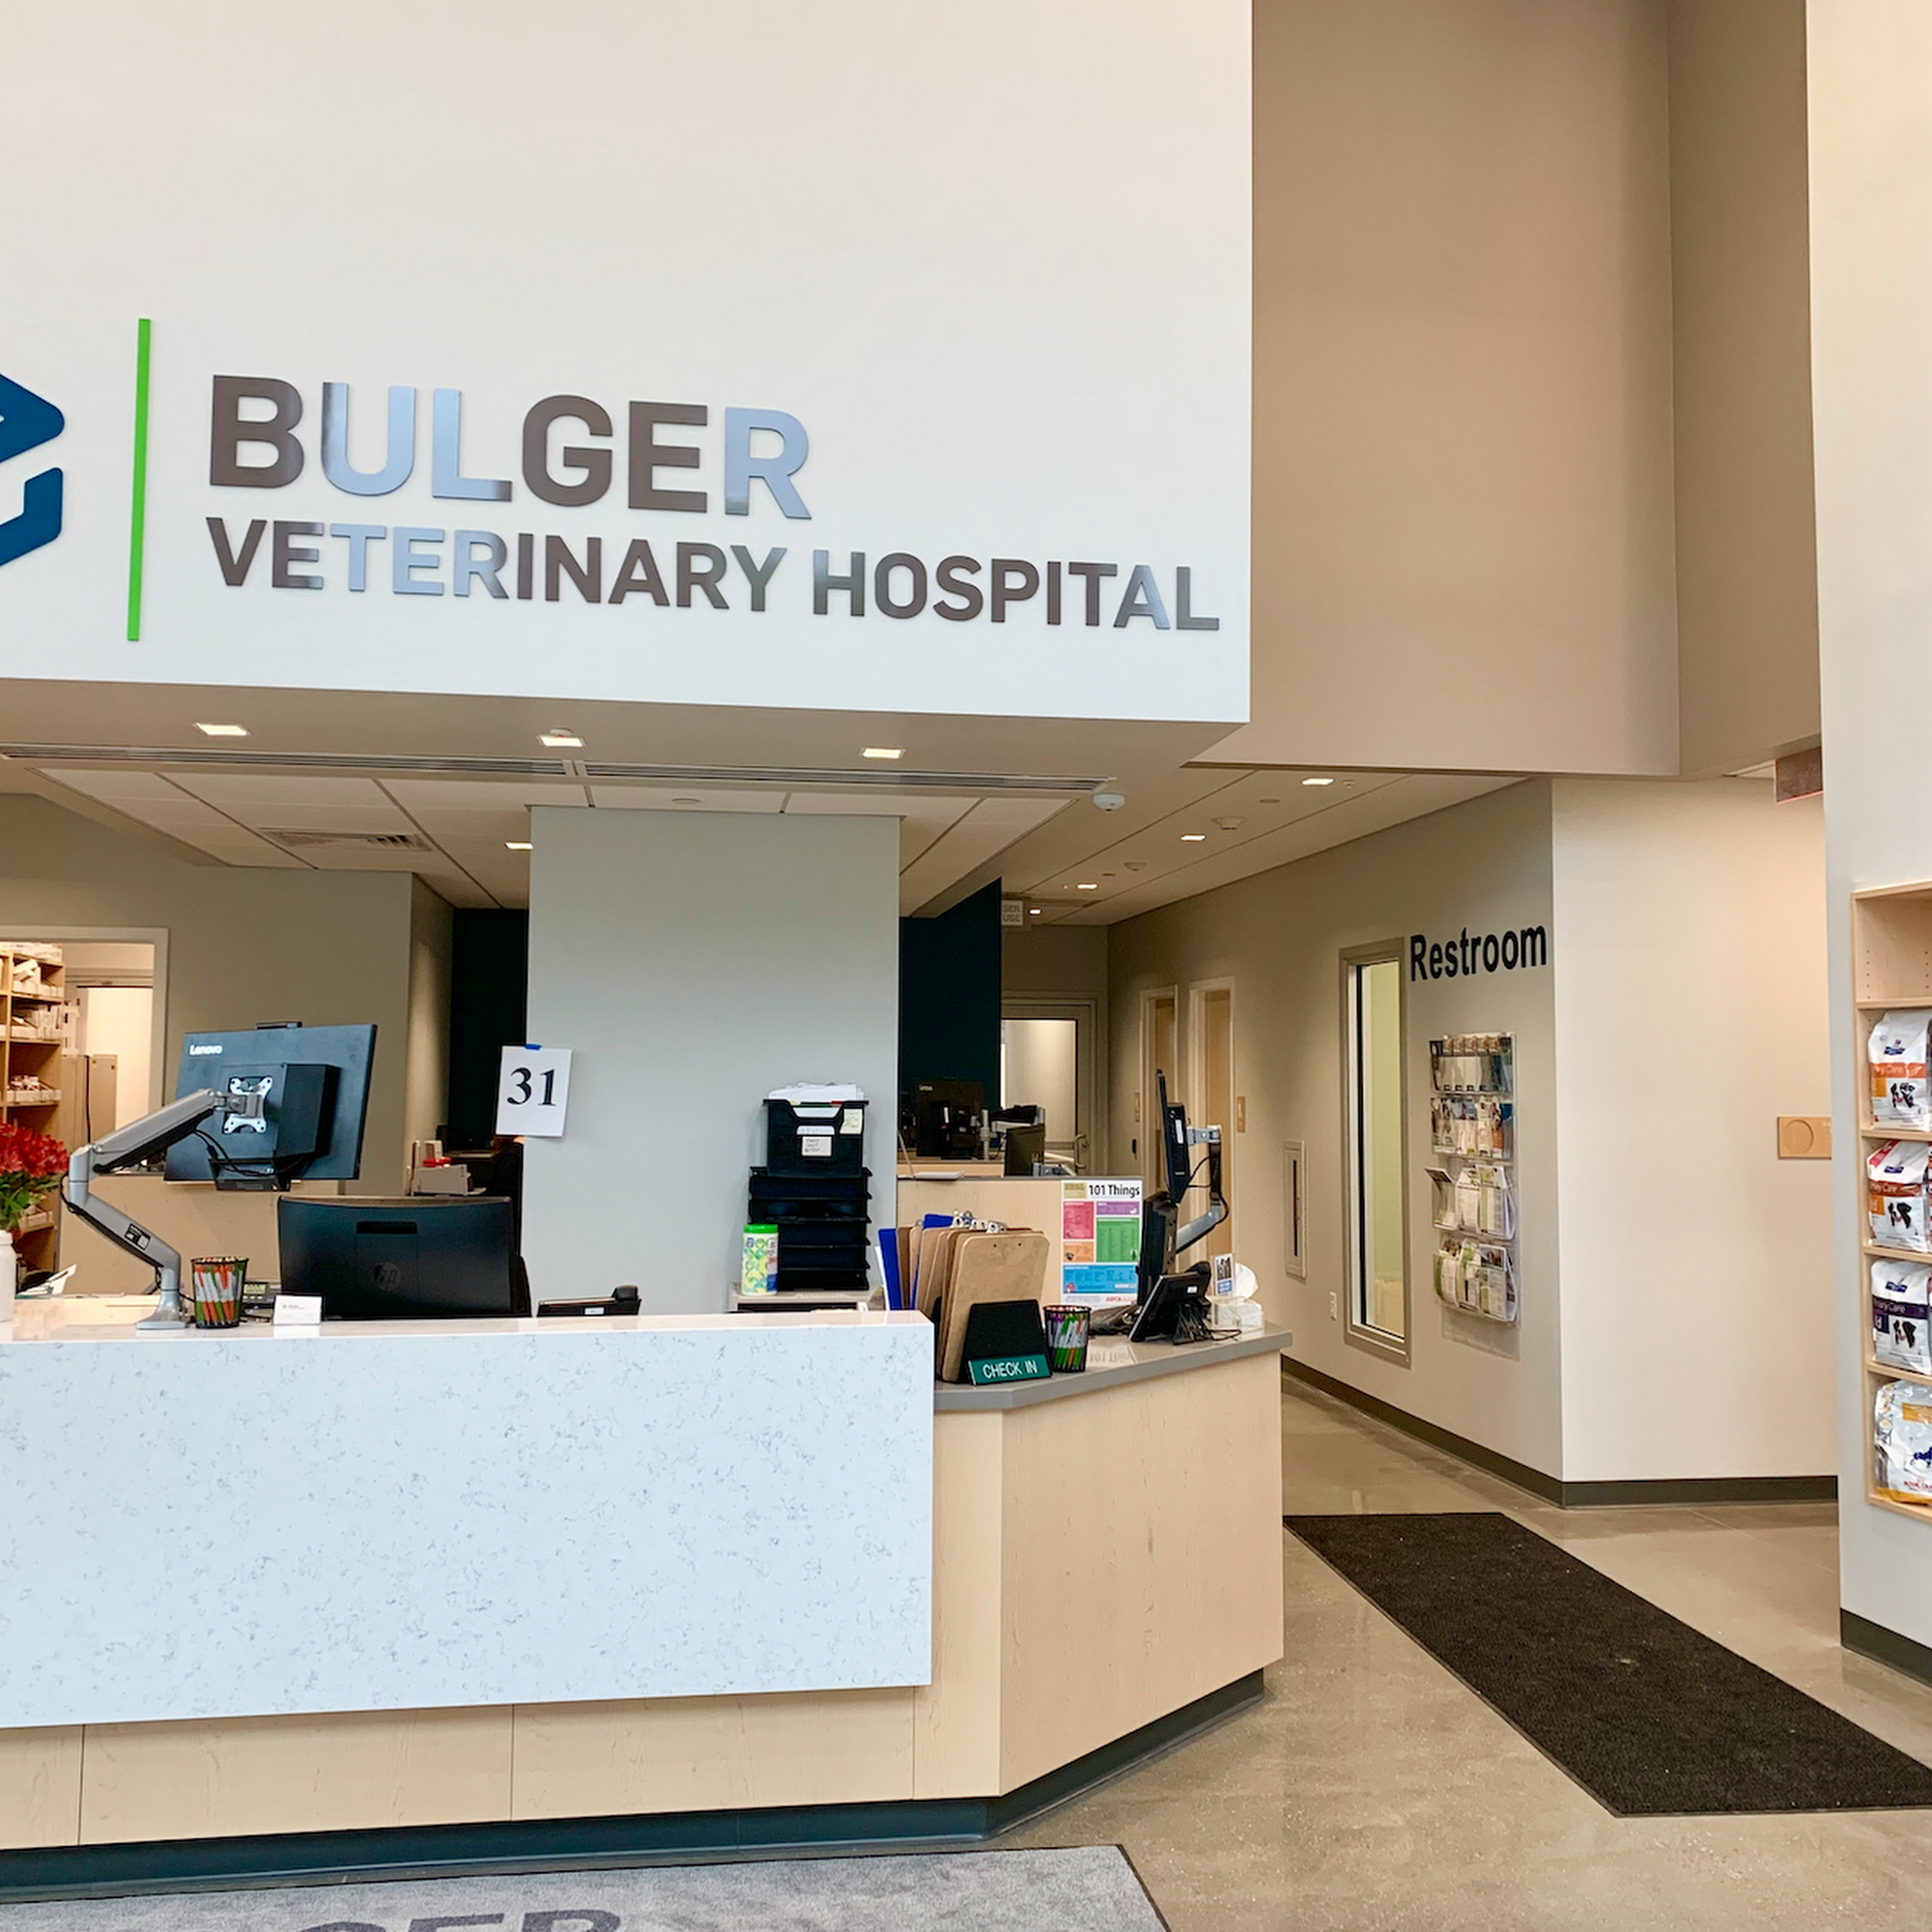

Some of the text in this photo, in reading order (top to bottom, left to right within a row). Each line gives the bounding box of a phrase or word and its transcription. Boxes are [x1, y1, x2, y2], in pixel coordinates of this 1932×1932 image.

[209, 374, 812, 520] BULGER
[205, 517, 1220, 631] VETERINARY HOSPITAL
[1409, 924, 1547, 982] Restroom
[189, 1044, 222, 1056] Lenovo
[506, 1066, 556, 1107] 31
[1089, 1184, 1106, 1196] 101
[1108, 1183, 1140, 1199] Things
[982, 1360, 1038, 1379] CHECK IN
